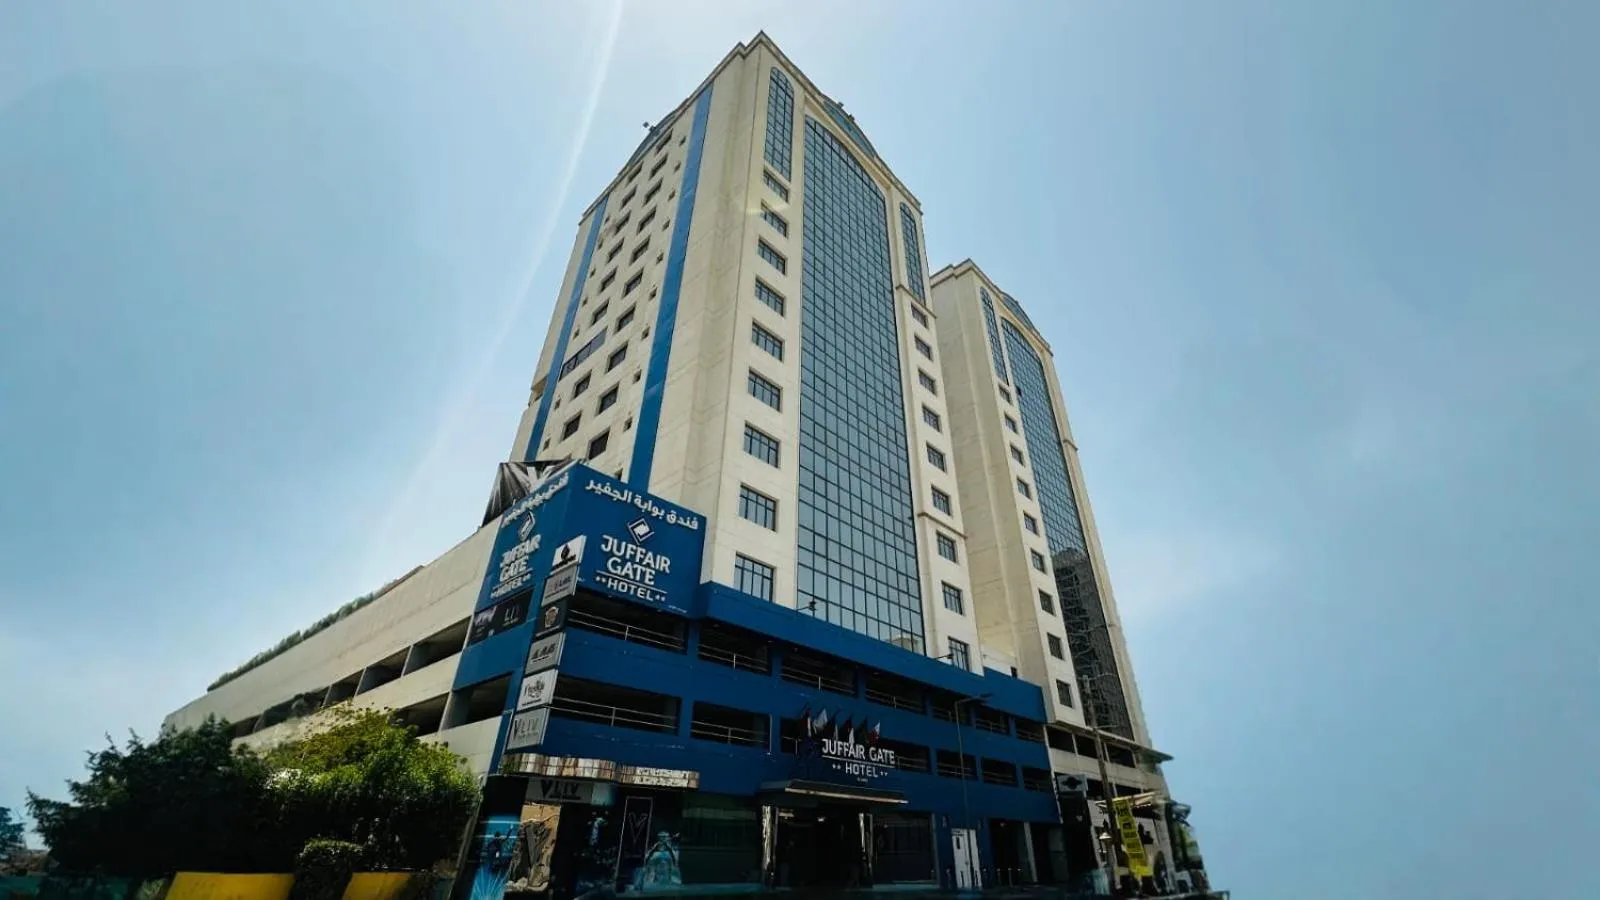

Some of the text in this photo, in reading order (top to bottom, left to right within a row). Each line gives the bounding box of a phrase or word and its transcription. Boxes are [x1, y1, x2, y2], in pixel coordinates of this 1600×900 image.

[585, 479, 699, 530] فندق بوابة الجفير
[600, 535, 671, 574] JUFFAIR
[500, 555, 529, 582] GATE
[607, 557, 656, 586] GATE
[607, 578, 654, 602] HOTEL
[821, 738, 896, 765] JUFFAIR GATE
[845, 762, 879, 778] HOTEL
